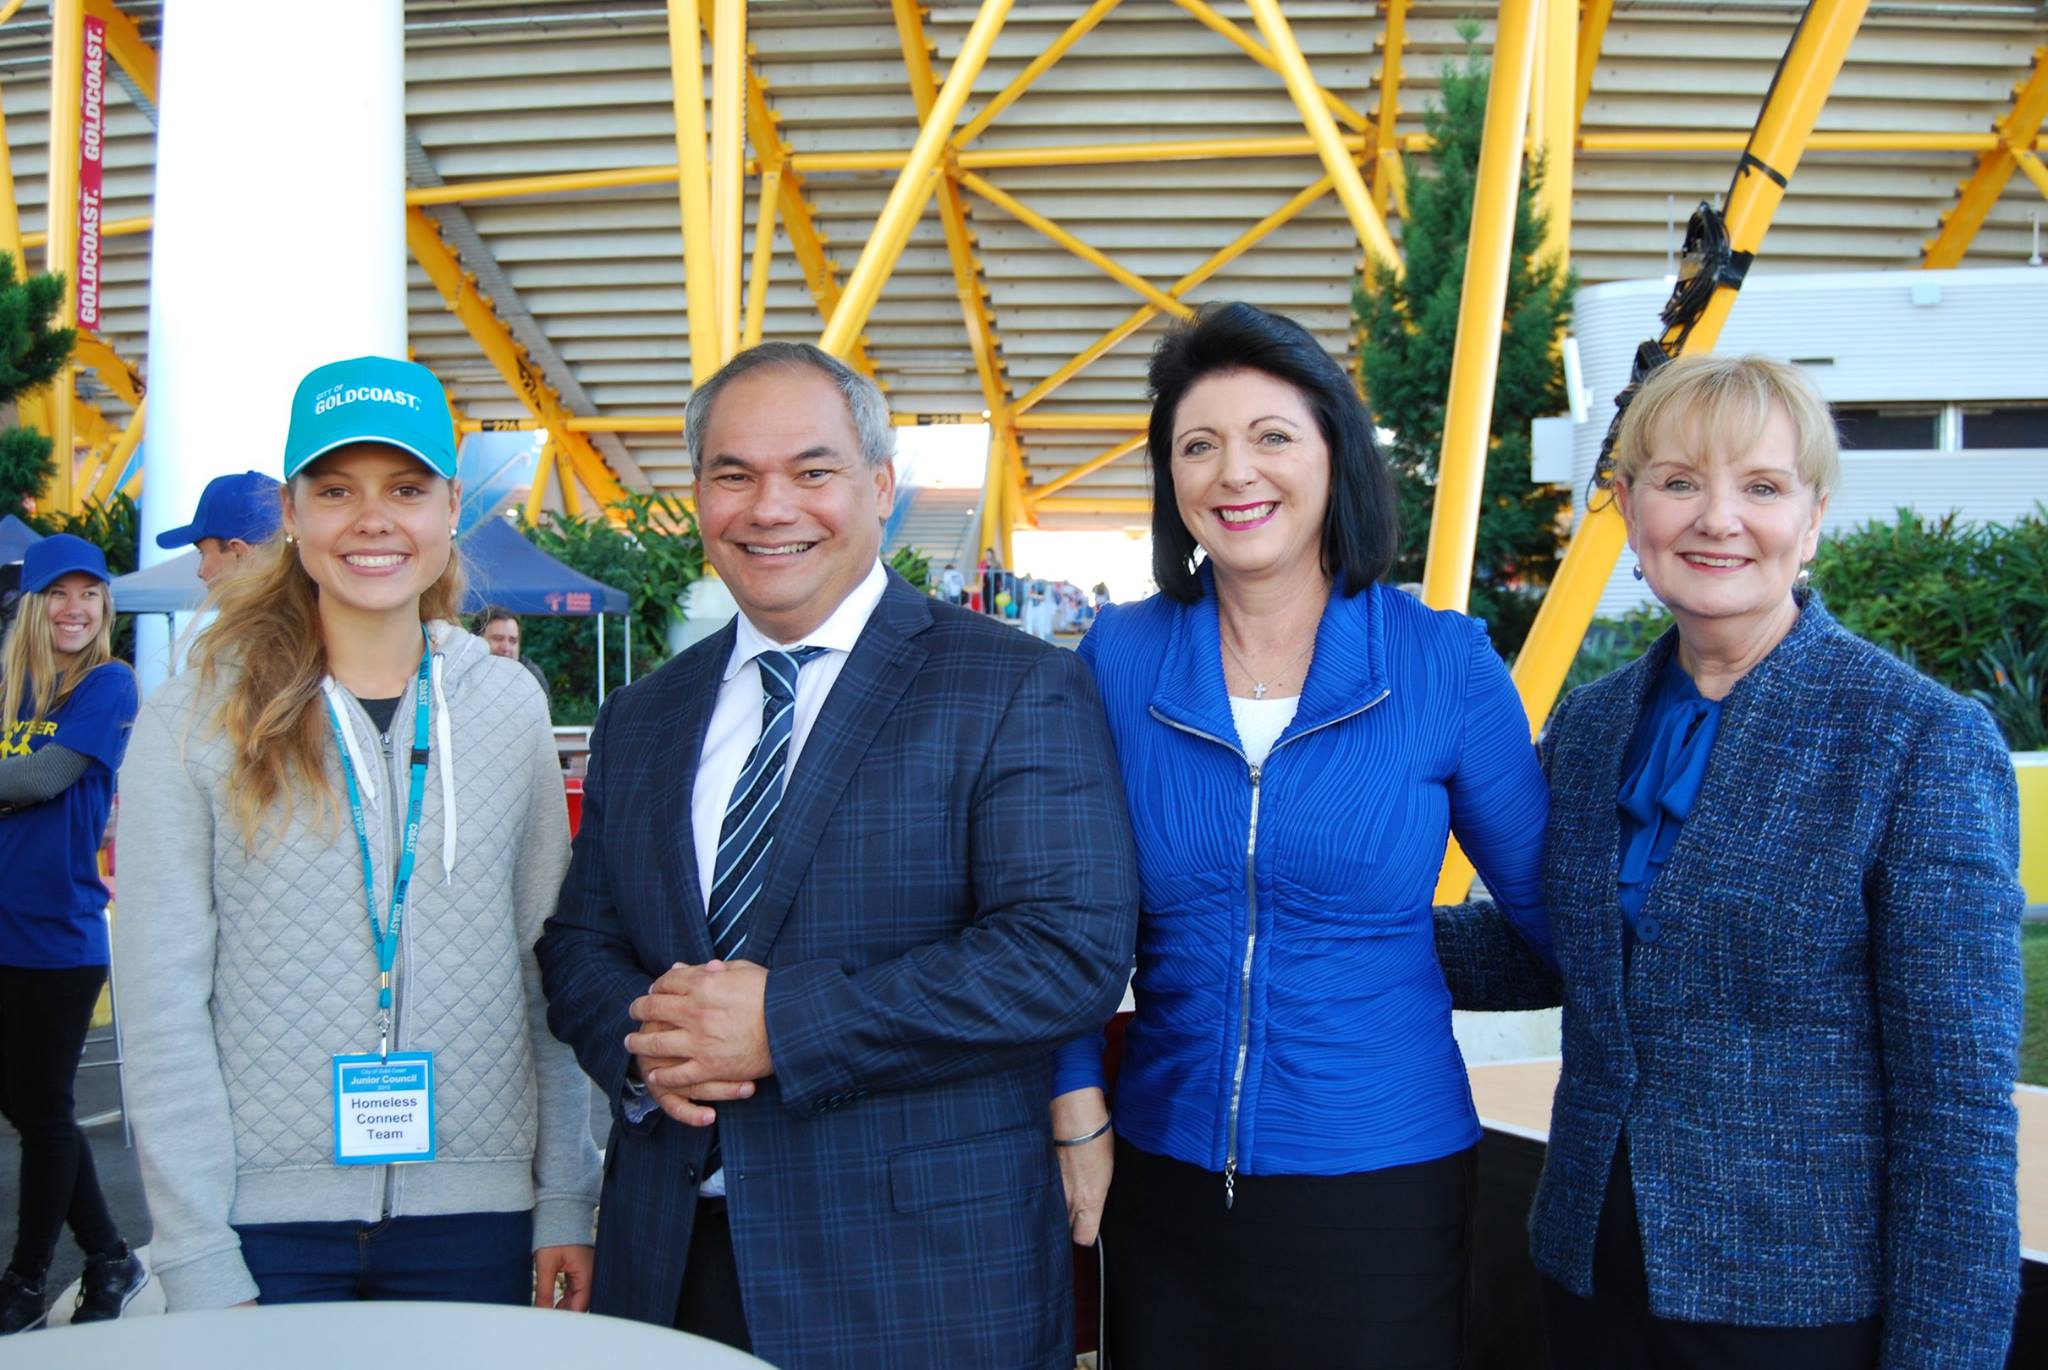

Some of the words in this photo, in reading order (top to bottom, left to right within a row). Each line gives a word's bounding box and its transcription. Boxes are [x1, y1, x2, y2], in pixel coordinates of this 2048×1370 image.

[351, 1076, 380, 1085] Junior
[382, 1074, 417, 1084] Council
[351, 1097, 418, 1109] Homeless
[356, 1113, 413, 1125] Connect
[366, 1128, 403, 1140] Team
